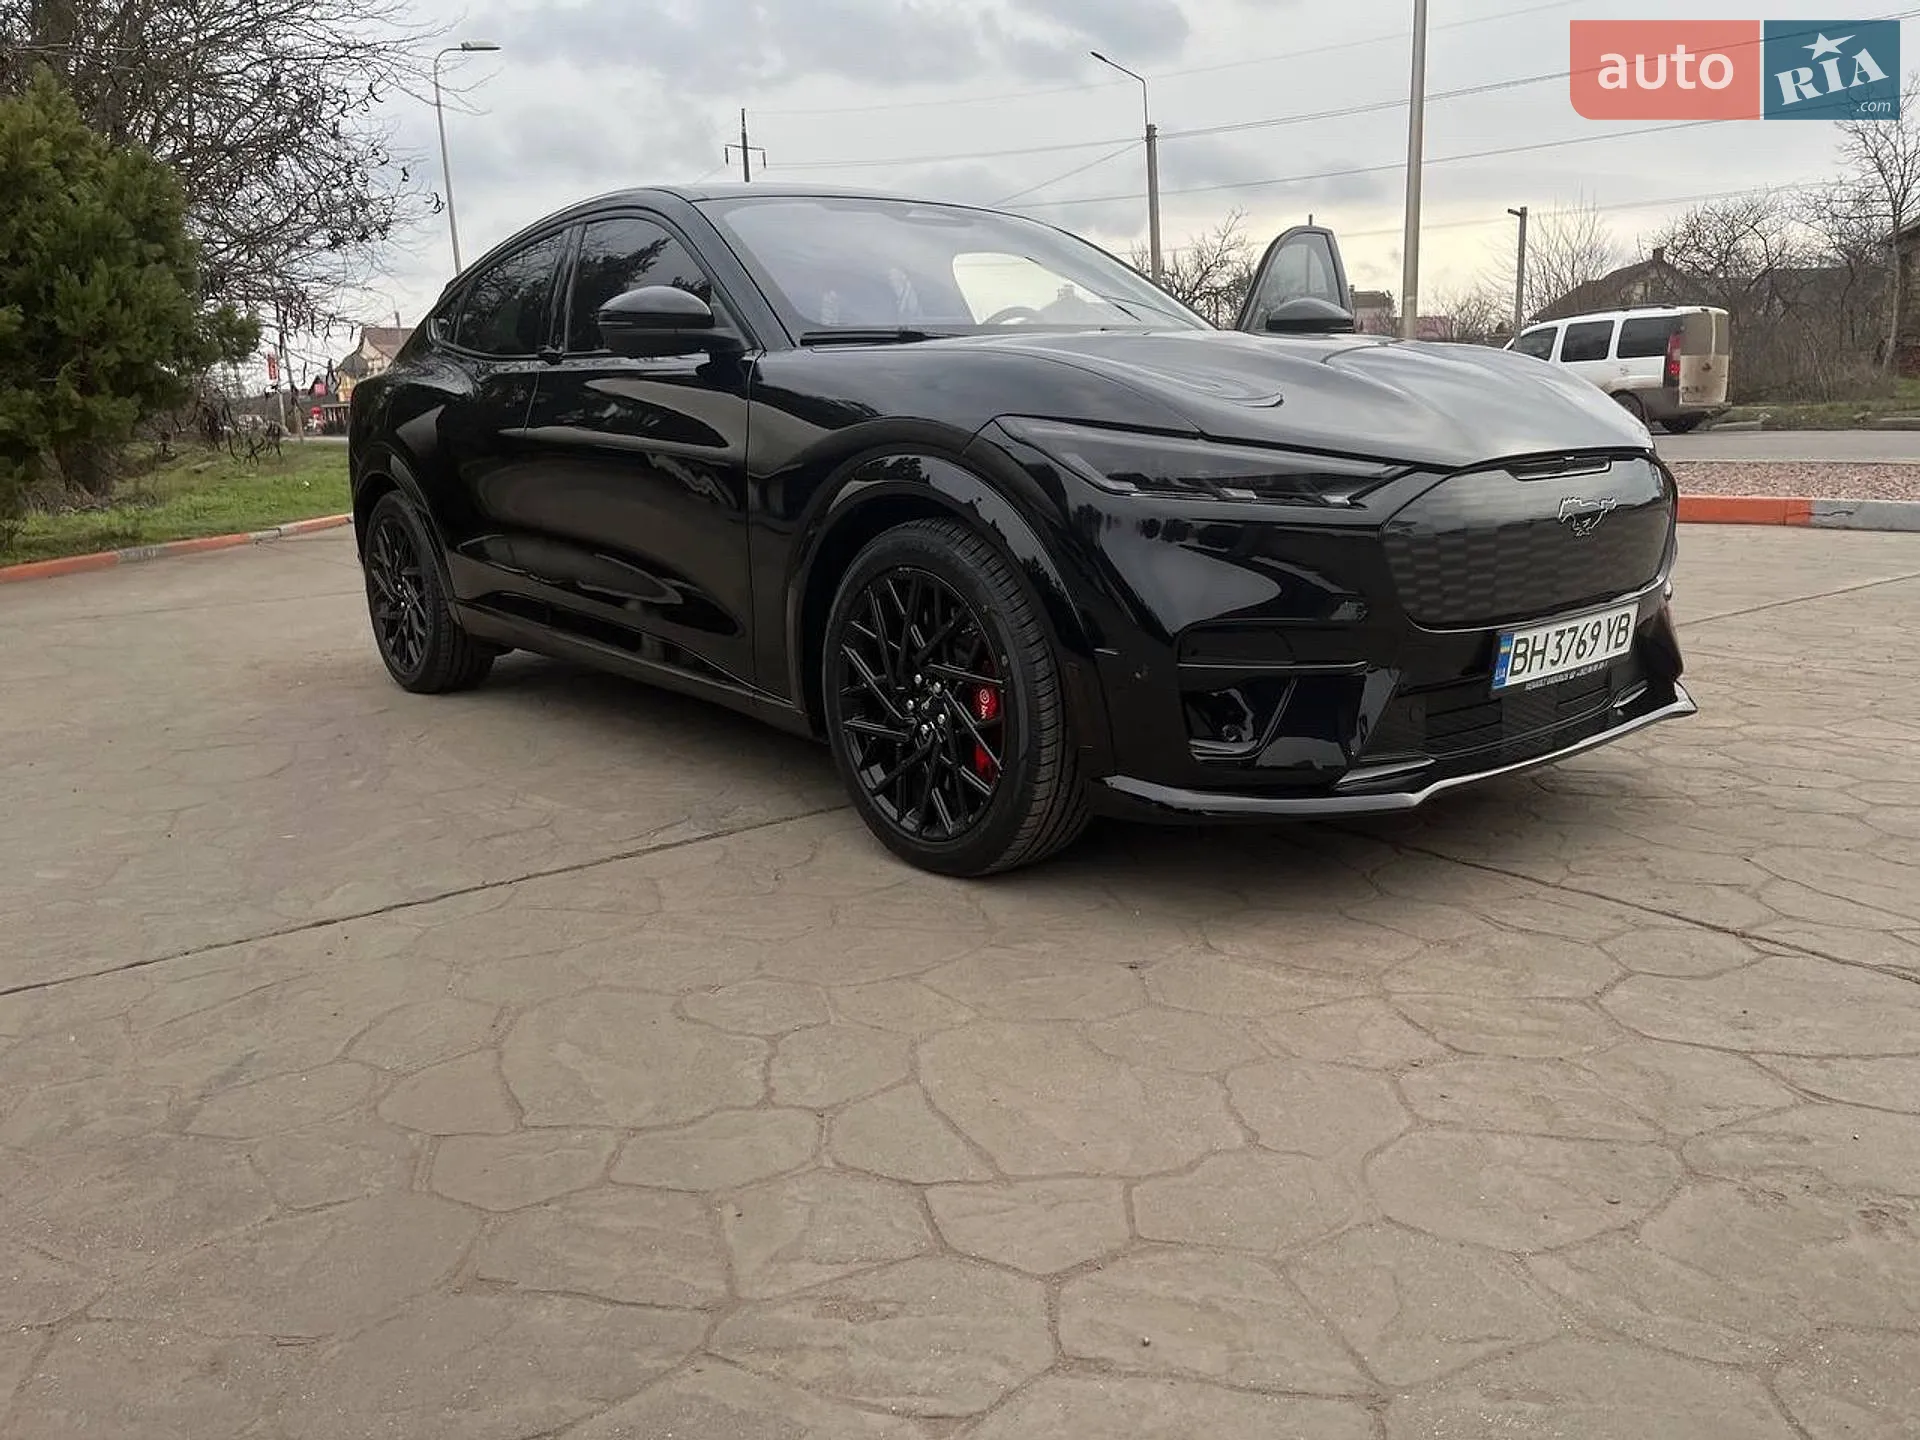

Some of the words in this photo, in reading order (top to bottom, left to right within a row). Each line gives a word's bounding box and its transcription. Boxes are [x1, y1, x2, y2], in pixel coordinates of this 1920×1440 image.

[1509, 632, 1549, 677] BH
[1550, 620, 1601, 667] 3769
[1605, 612, 1631, 653] YB
